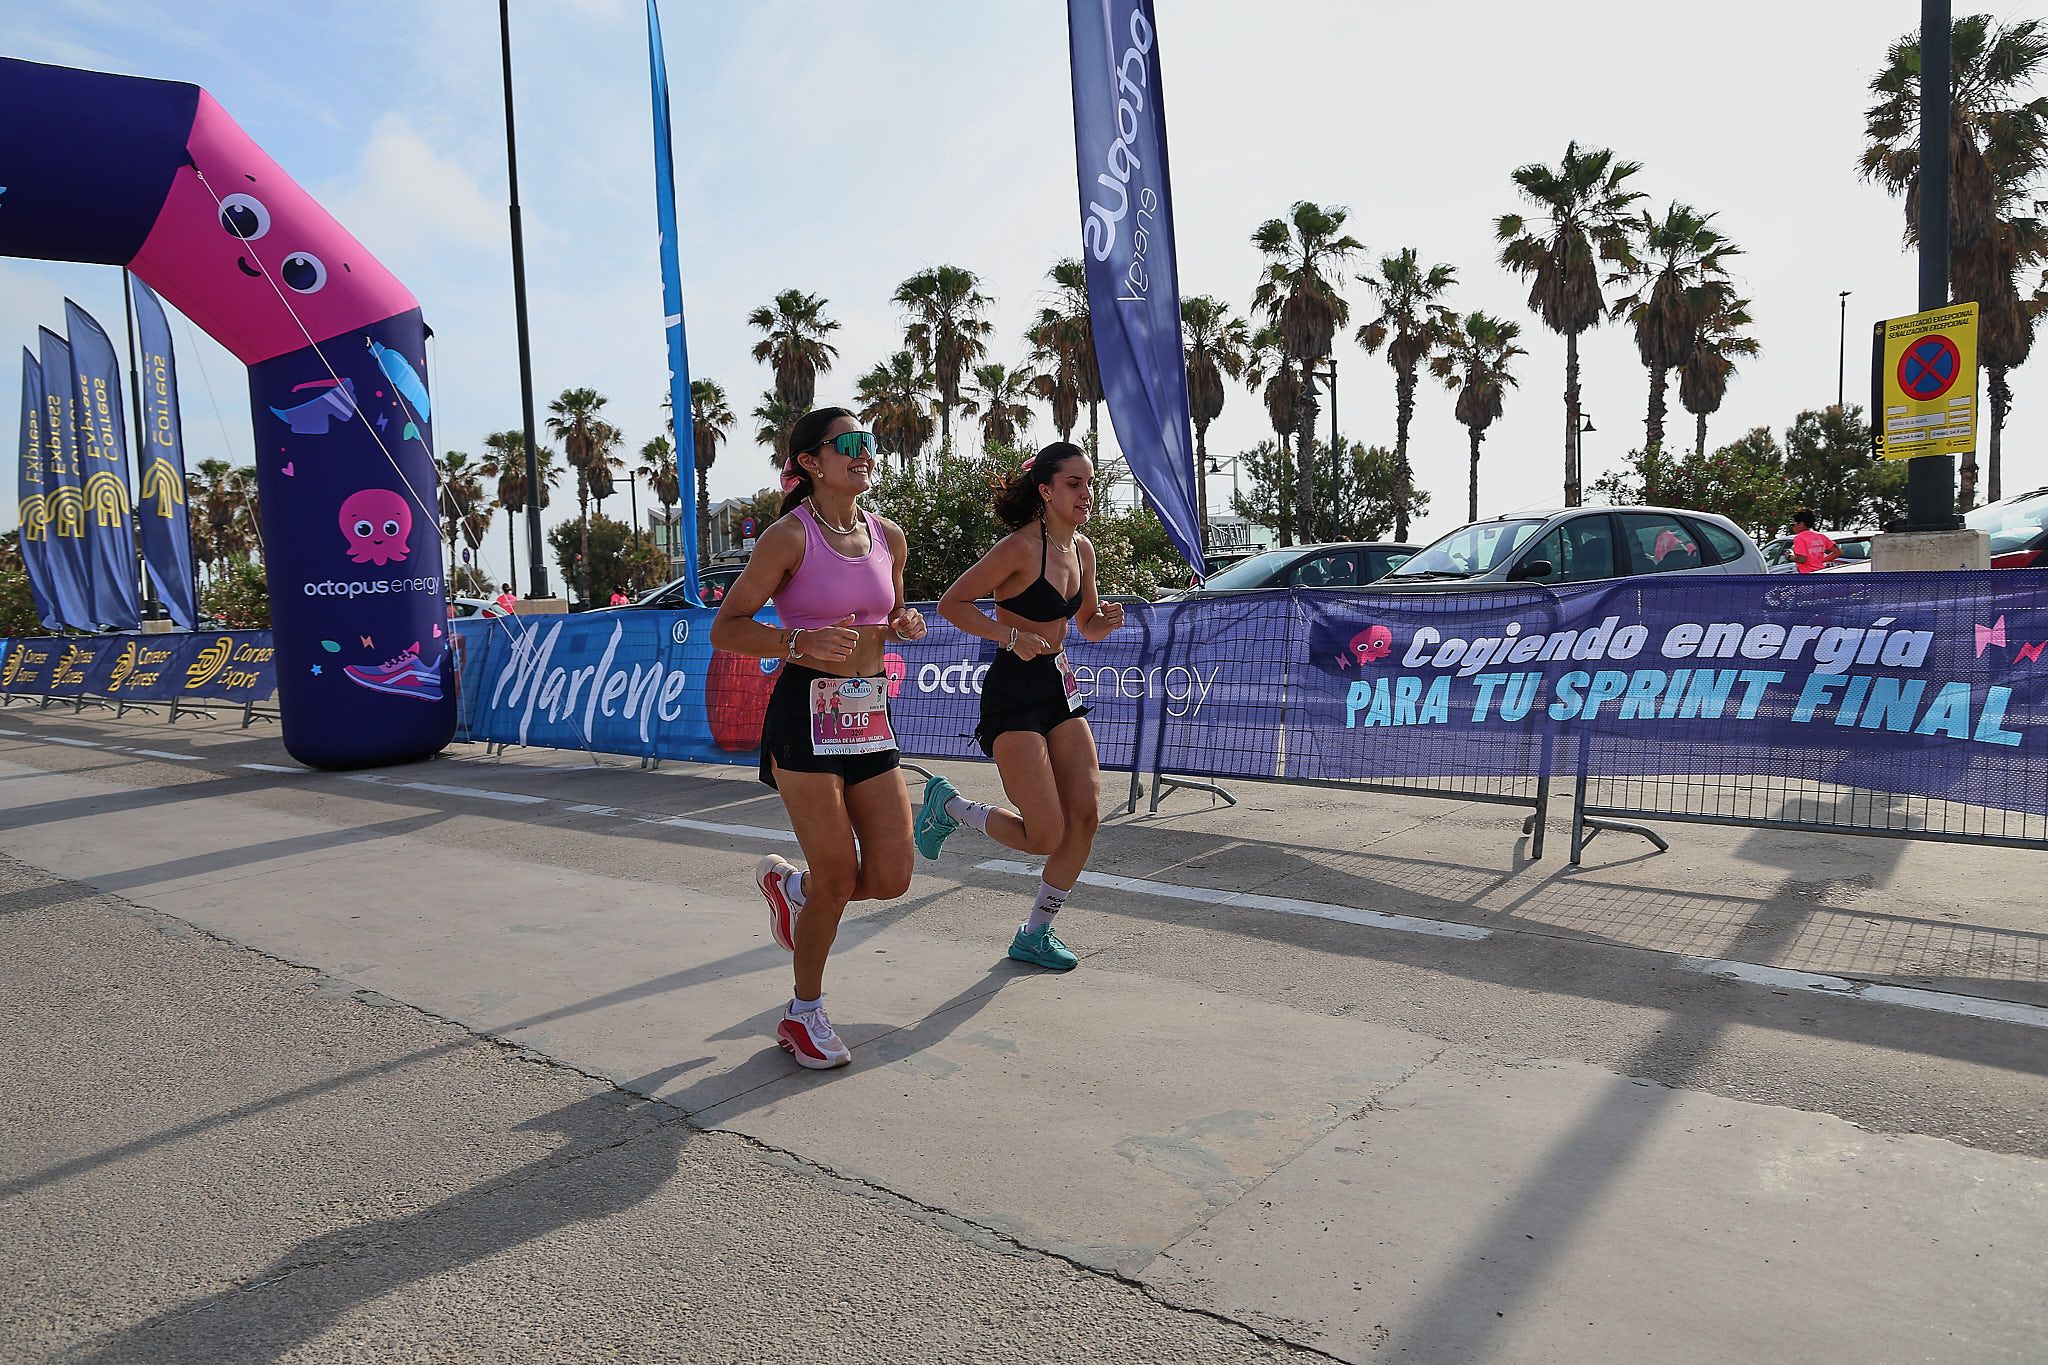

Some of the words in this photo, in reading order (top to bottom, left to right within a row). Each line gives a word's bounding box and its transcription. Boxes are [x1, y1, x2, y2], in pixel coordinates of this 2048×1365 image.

[303, 579, 390, 599] octopus
[390, 576, 441, 595] energy
[1401, 615, 1649, 677] Cogiendo
[1660, 616, 1934, 675] energía
[490, 618, 686, 749] Marlene
[1074, 665, 1219, 717] energy
[1345, 675, 1452, 729] PARA
[1471, 671, 1543, 723] TU
[1550, 668, 1786, 722] SPRINT
[1790, 673, 2023, 747] FINAL
